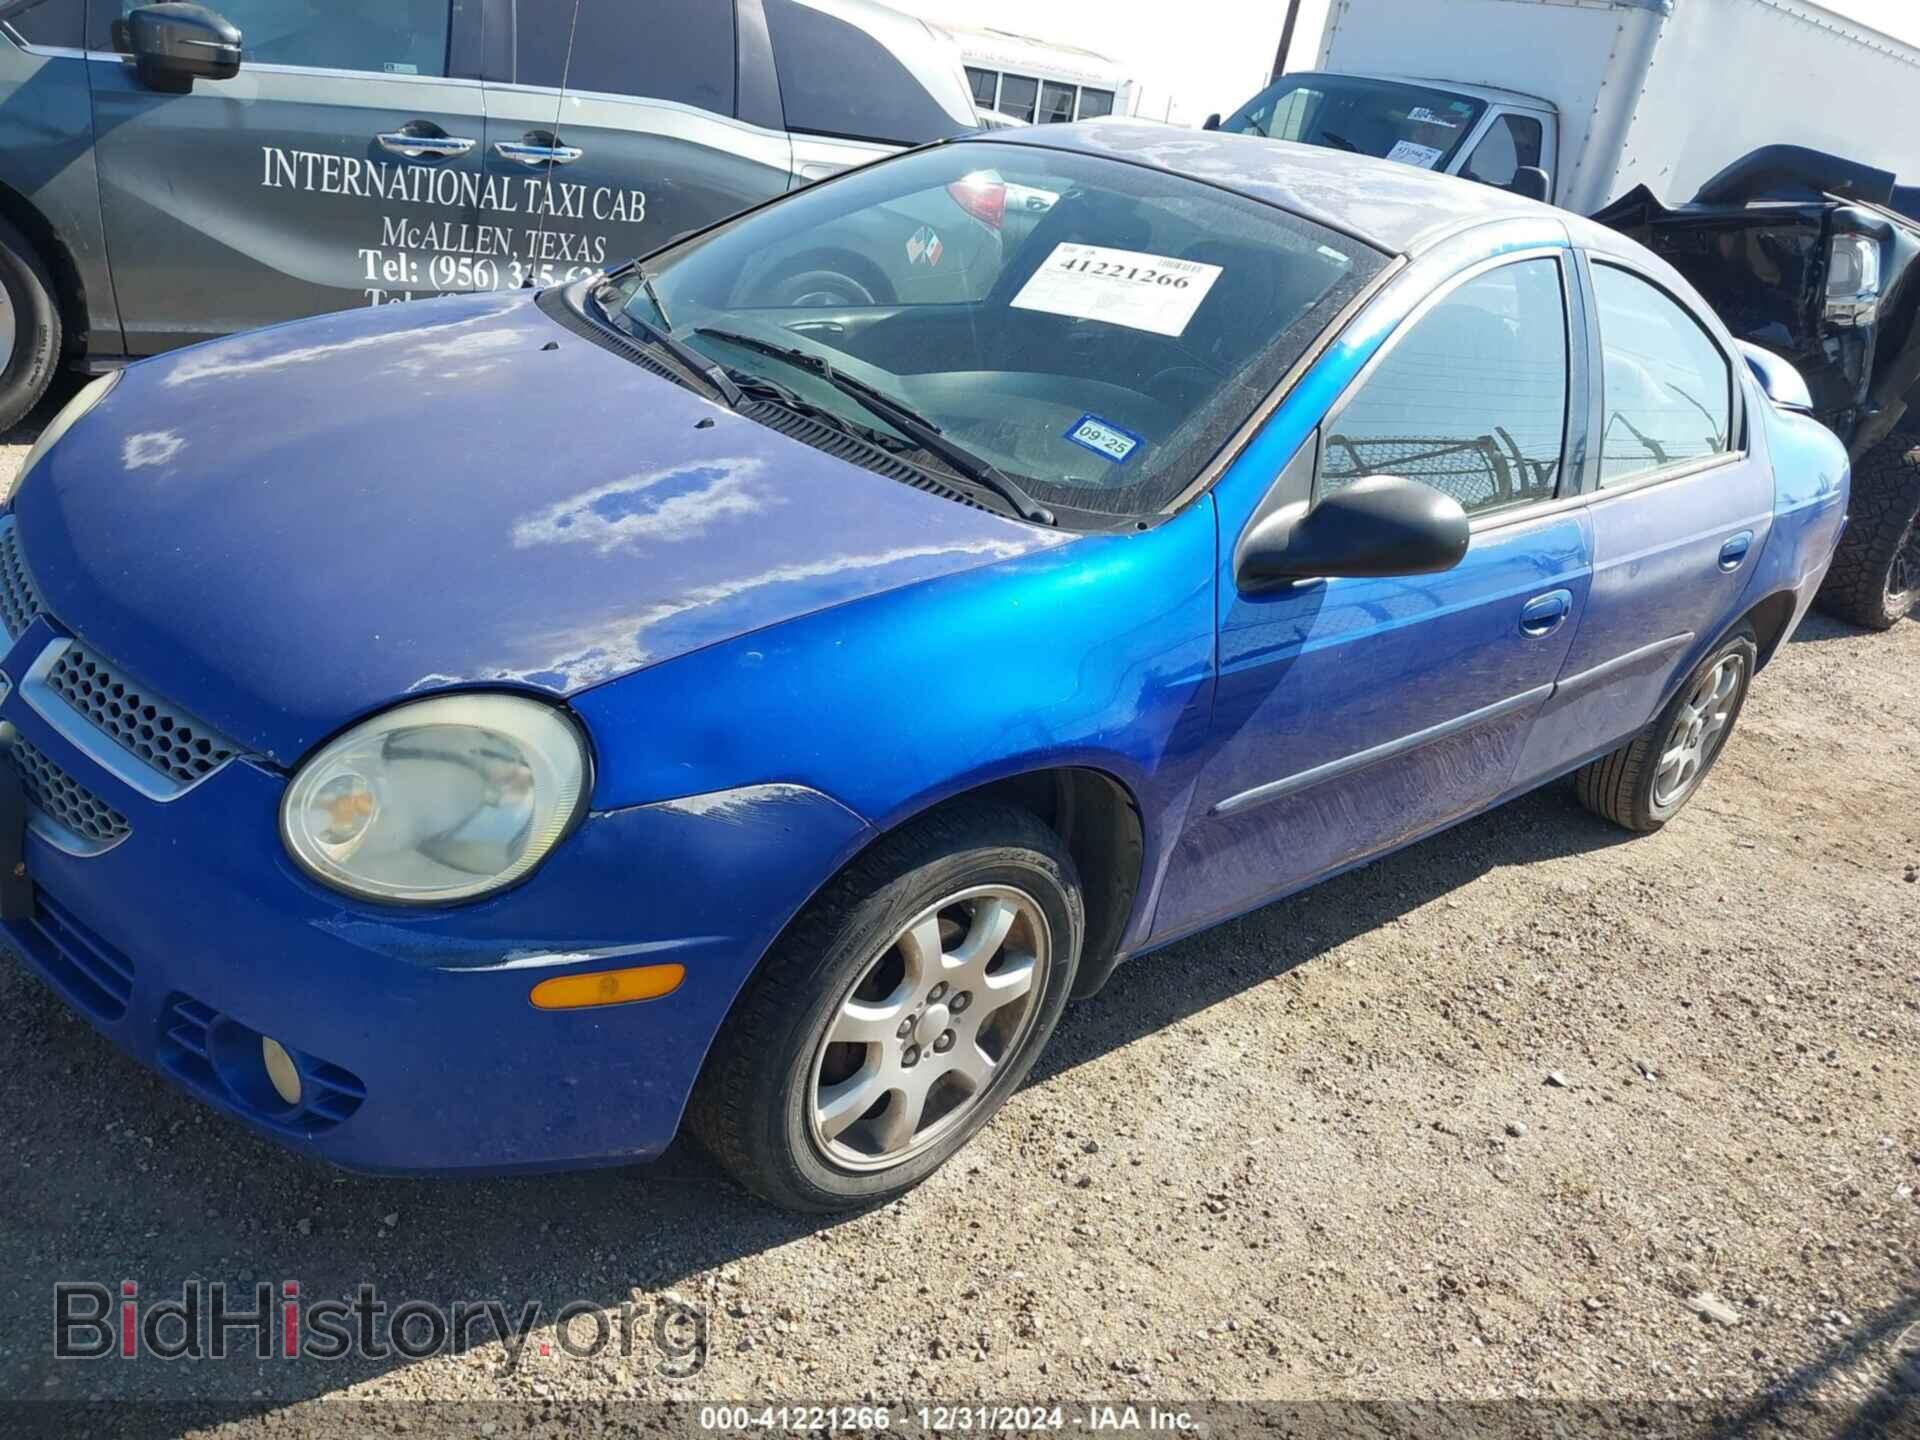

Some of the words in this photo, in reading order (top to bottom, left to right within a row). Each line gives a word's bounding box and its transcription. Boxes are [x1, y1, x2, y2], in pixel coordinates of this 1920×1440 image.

[262, 146, 517, 212] INTERNATIONAL
[524, 178, 588, 219] TAXI
[593, 186, 647, 223] CAB
[381, 215, 518, 263] McALLEN,
[525, 229, 606, 264] TEXAS
[358, 249, 418, 283] Tel:
[429, 255, 499, 292] (956)
[1059, 258, 1190, 289] 41221266
[1079, 426, 1102, 441] 09
[1104, 438, 1127, 454] 25
